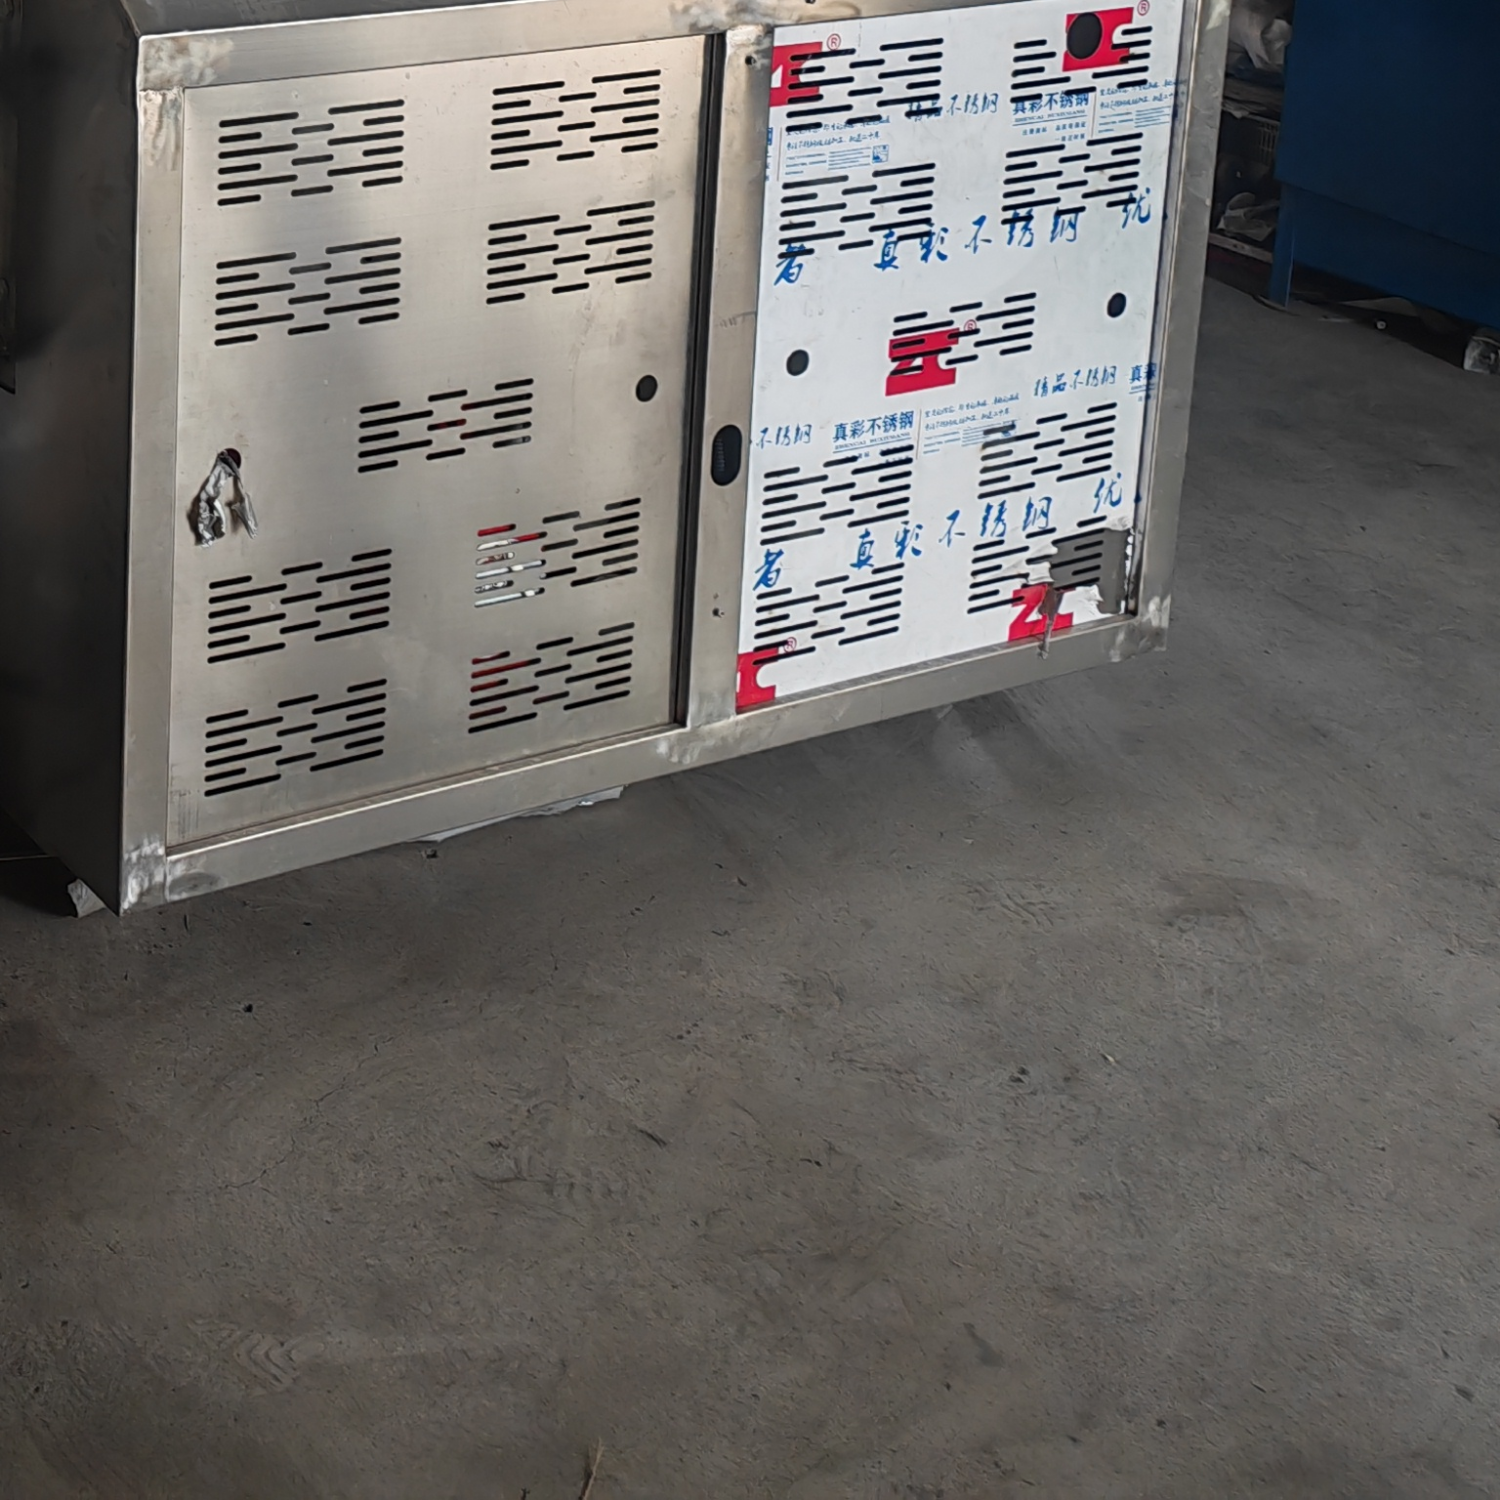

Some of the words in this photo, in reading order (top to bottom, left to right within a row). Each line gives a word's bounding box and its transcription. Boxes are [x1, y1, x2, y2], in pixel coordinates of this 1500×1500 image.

[832, 410, 914, 443] 真彩不锈钢
[850, 496, 1053, 570] 真彩不锈钢
